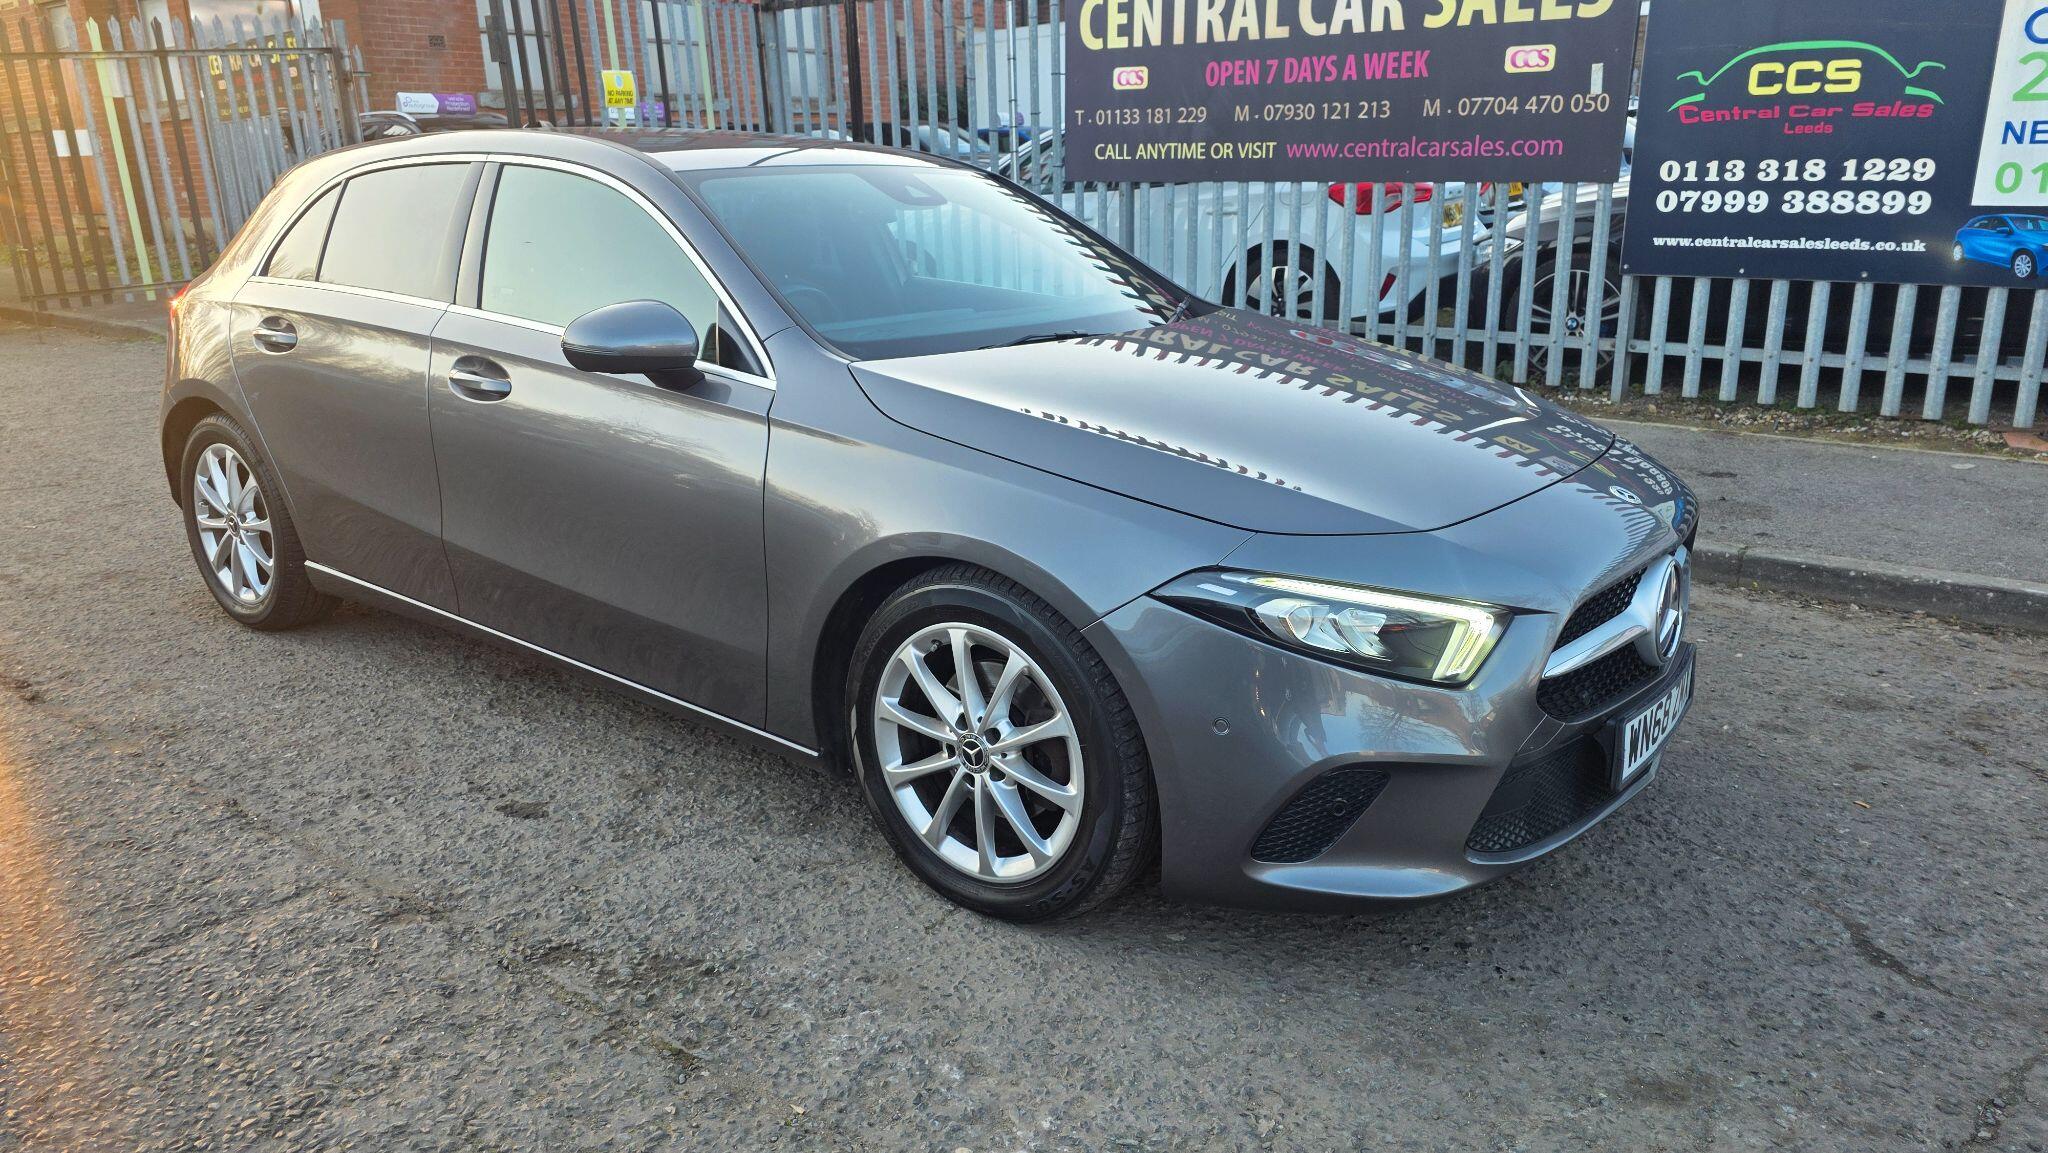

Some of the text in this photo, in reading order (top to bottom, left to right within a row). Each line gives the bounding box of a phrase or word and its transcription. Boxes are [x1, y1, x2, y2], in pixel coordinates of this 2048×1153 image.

[1206, 50, 1431, 87] OPEN 7 DAYS A WEEK
[1748, 59, 1862, 96] CCS
[1096, 109, 1140, 125] 01133
[1146, 108, 1171, 124] 181
[1177, 107, 1207, 123] 229
[1264, 103, 1315, 121] 07930
[1322, 102, 1350, 120] 121
[1358, 101, 1391, 119] 213
[1458, 97, 1519, 116] 07704
[1524, 95, 1564, 114] 470
[1570, 93, 1610, 113] 050
[1679, 101, 1935, 124] Central Car Sales
[1783, 122, 1833, 134] Leeds
[1094, 135, 1564, 160] CALL ANYTIME OR VISIT www.centralcarsales.com
[1659, 157, 1936, 182] 0113 318 1229
[1655, 190, 1932, 215] 07999 388899
[1653, 235, 1927, 252] www.centralcarsalesleeds.co.uk
